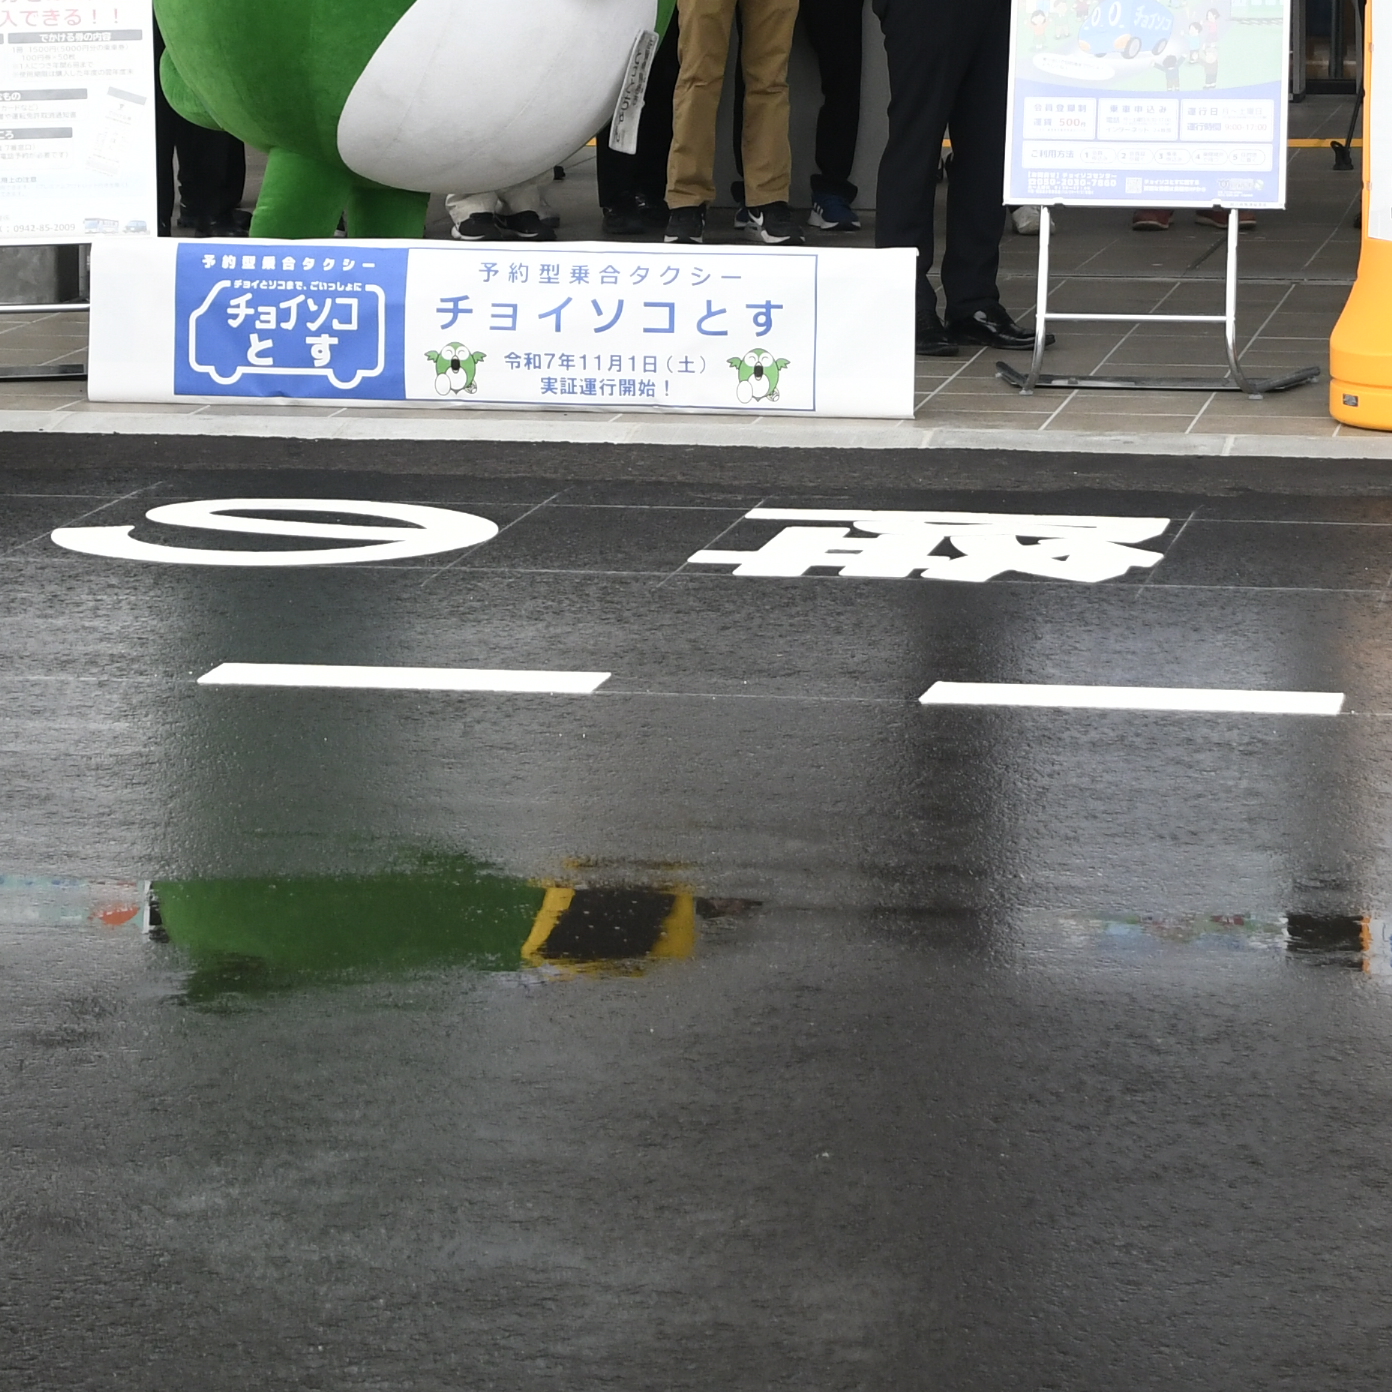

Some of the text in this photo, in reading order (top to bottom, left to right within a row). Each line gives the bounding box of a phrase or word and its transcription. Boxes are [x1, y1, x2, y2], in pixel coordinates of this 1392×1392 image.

[1133, 5, 1172, 32] チョイソコ
[1058, 118, 1087, 128] 500円
[1188, 106, 1218, 116] 運行日
[1031, 149, 1075, 159] ご利用方法
[202, 254, 376, 272] 予約型乗合タクシー
[478, 261, 742, 286] 予約型乗合タクシー
[227, 293, 359, 331] チョイソコ
[435, 294, 784, 338] チョイソコとす
[246, 333, 339, 367] とす
[503, 351, 710, 375] 令和7年11月1日（土）
[540, 376, 671, 398] 実証運行開始！
